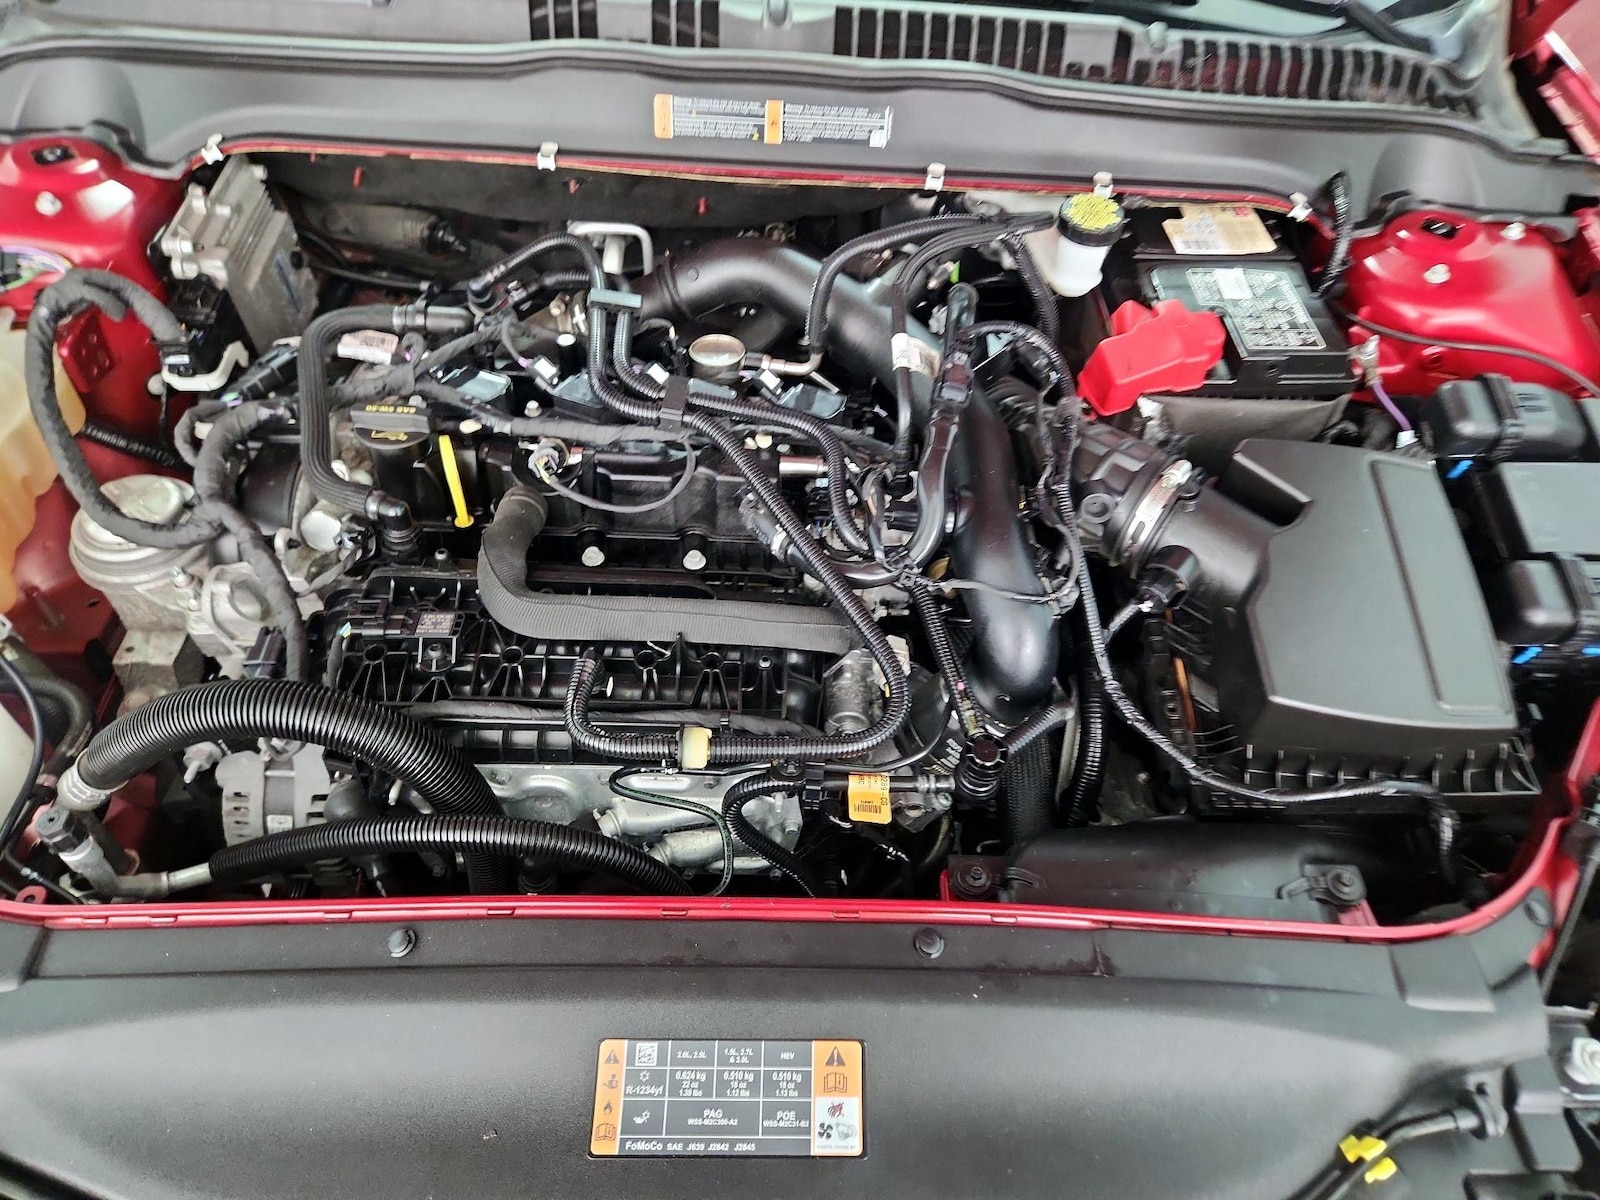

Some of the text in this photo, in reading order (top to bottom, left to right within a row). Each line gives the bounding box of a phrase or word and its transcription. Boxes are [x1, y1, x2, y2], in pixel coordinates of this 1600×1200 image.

[780, 1051, 795, 1060] HEV
[675, 1070, 706, 1082] 0.624 kg
[723, 1070, 754, 1083] 0.510 kg
[772, 1071, 802, 1083] 0.510 kg
[739, 1080, 746, 1089] oz
[787, 1081, 795, 1089] oz
[625, 1085, 664, 1096] R-1234yf
[692, 1089, 702, 1097] lbs
[726, 1088, 750, 1097] 1.12 lbs
[775, 1089, 799, 1097] 1.12 lbs
[703, 1108, 723, 1119] PAG
[776, 1110, 796, 1120] POE
[625, 1140, 663, 1151] FoMoCo
[666, 1142, 683, 1151] SAE
[686, 1142, 705, 1151] J639
[707, 1142, 729, 1151] J2842
